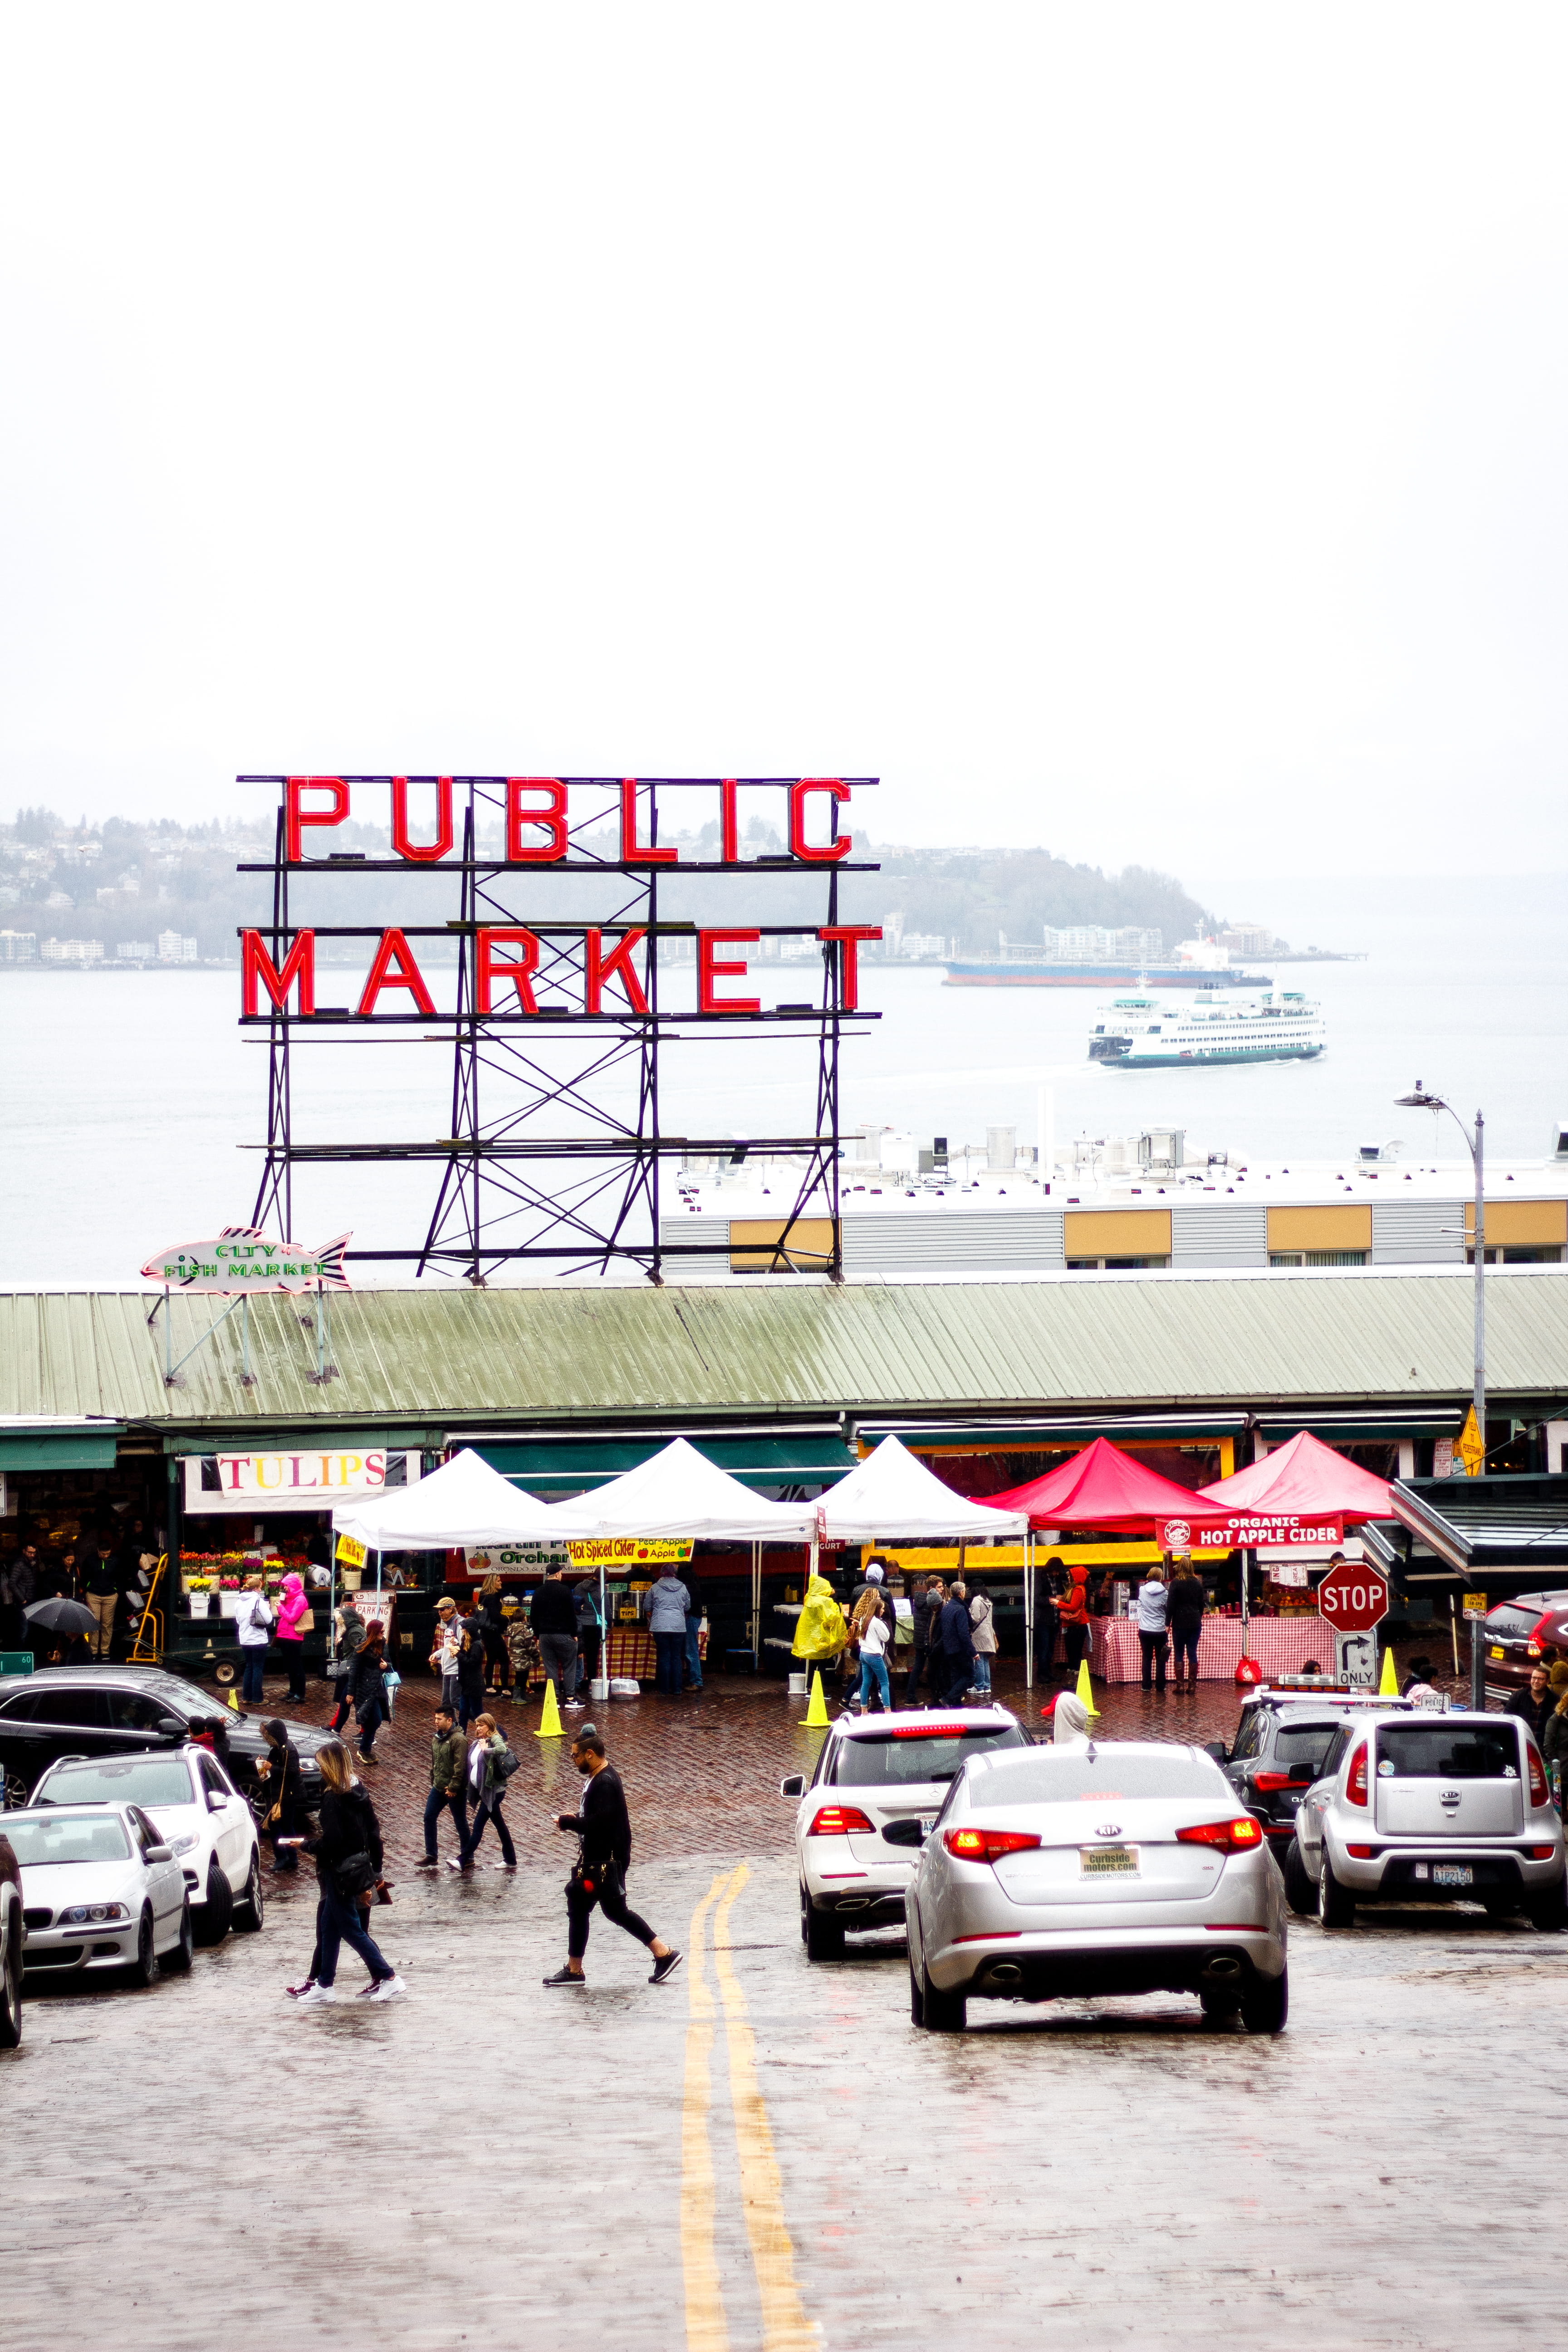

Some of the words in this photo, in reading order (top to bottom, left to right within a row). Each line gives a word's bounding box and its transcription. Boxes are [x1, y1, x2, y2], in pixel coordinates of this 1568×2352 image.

[286, 776, 852, 862] PUBLIC
[241, 927, 882, 1015] MARKET
[216, 1245, 277, 1258] CITY
[164, 1263, 218, 1278] FISH
[229, 1263, 327, 1277] MARKET
[220, 1454, 385, 1490] TULIPS
[1228, 1517, 1299, 1528] ORGANIC
[638, 1538, 687, 1546] Pear-Apple
[1201, 1530, 1233, 1544] HOT
[1238, 1529, 1285, 1544] APPLE
[1289, 1528, 1338, 1542] CIDER
[569, 1542, 585, 1559] Hot
[587, 1540, 612, 1561] Spiced
[614, 1539, 636, 1556] Cider
[650, 1549, 675, 1558] Apple
[500, 1551, 569, 1563] Orchar
[1324, 1585, 1382, 1611] STOP
[358, 1606, 389, 1615] PARKNG
[1341, 1672, 1373, 1684] ONLY
[1426, 1699, 1446, 1707] POLICE
[1098, 1826, 1118, 1836] KIA
[1089, 1853, 1130, 1863] Curbside
[1083, 1862, 1137, 1872] motors.com
